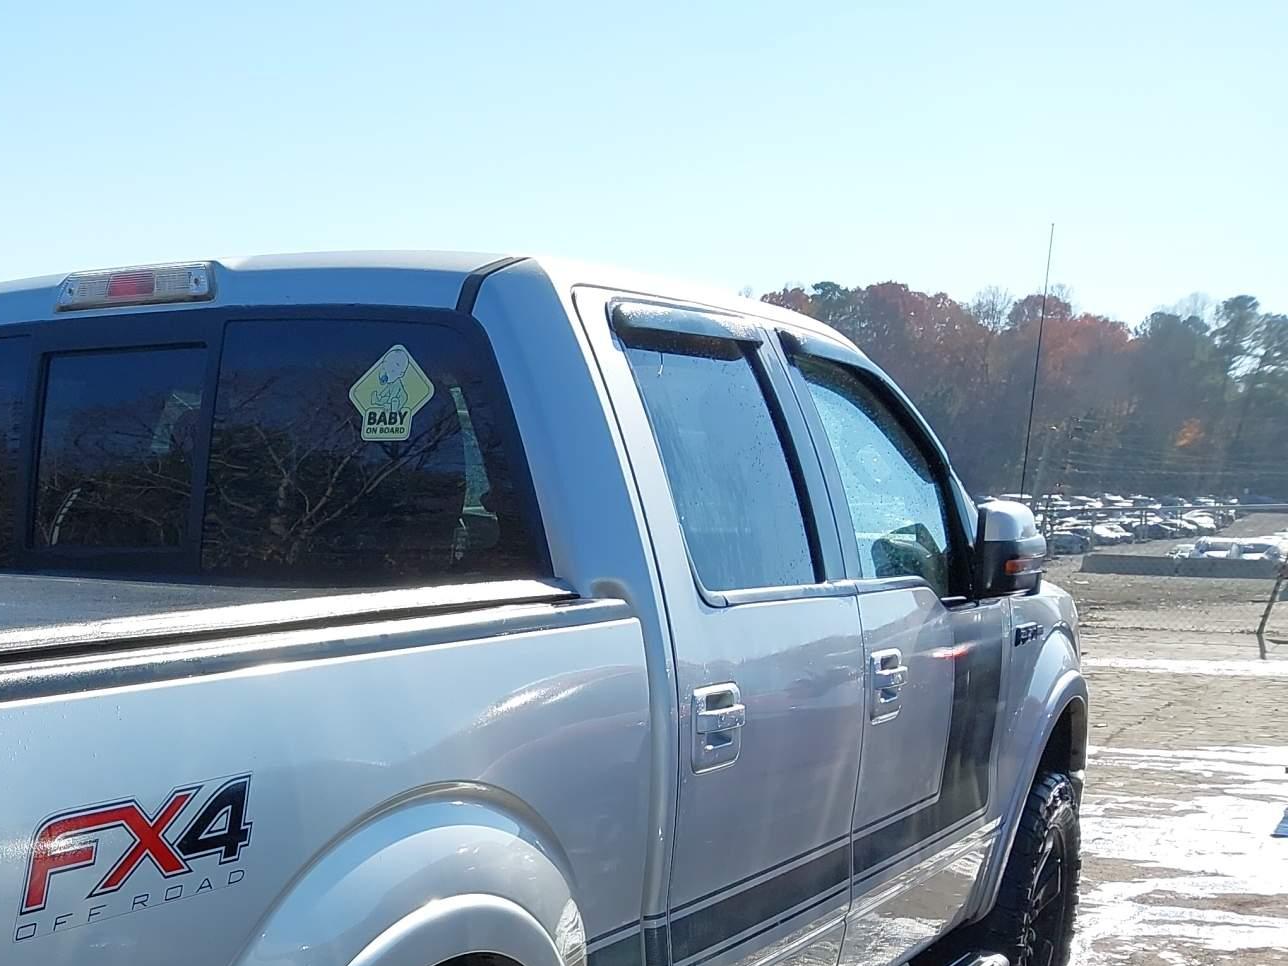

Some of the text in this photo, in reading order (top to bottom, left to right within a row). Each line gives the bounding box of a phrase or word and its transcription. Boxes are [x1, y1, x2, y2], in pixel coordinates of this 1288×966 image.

[367, 411, 408, 426] BABY
[379, 426, 405, 434] BOARD
[20, 775, 253, 916] FX4
[15, 870, 245, 941] OFF ROAD
